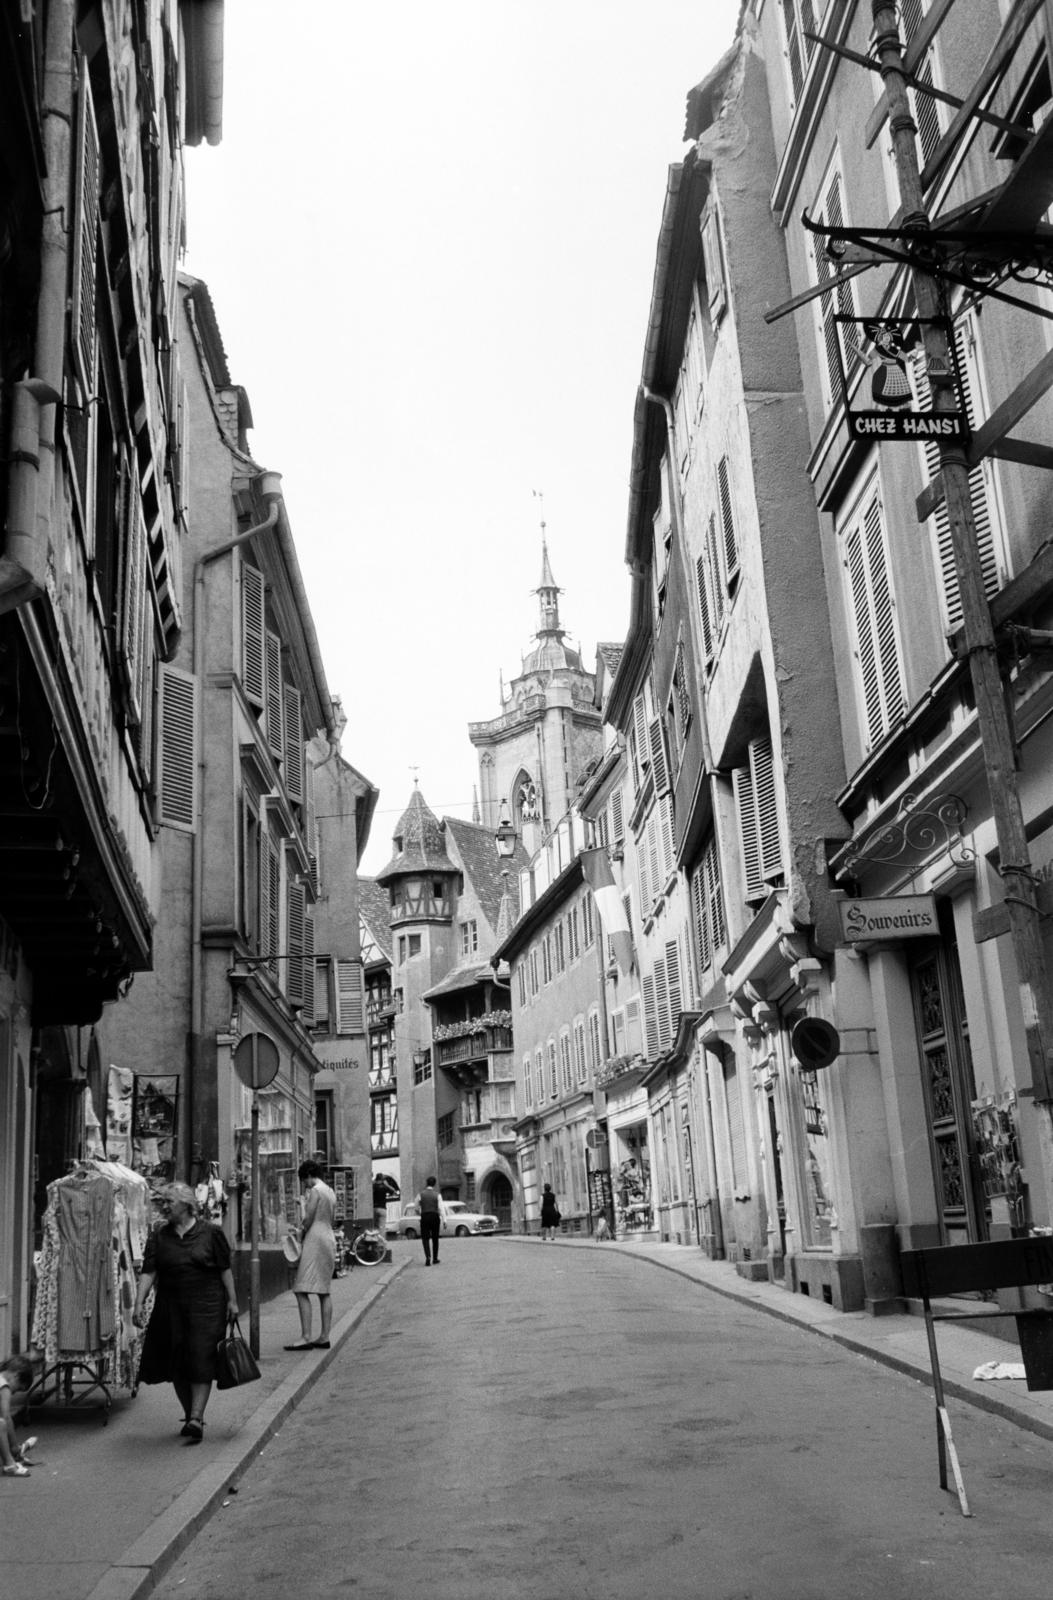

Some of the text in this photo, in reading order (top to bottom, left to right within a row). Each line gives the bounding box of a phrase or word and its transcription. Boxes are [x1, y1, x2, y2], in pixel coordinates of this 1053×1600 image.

[855, 417, 960, 435] CHEZ HANSI
[846, 906, 932, 932] Souvenirs
[322, 1057, 359, 1073] tiquités
